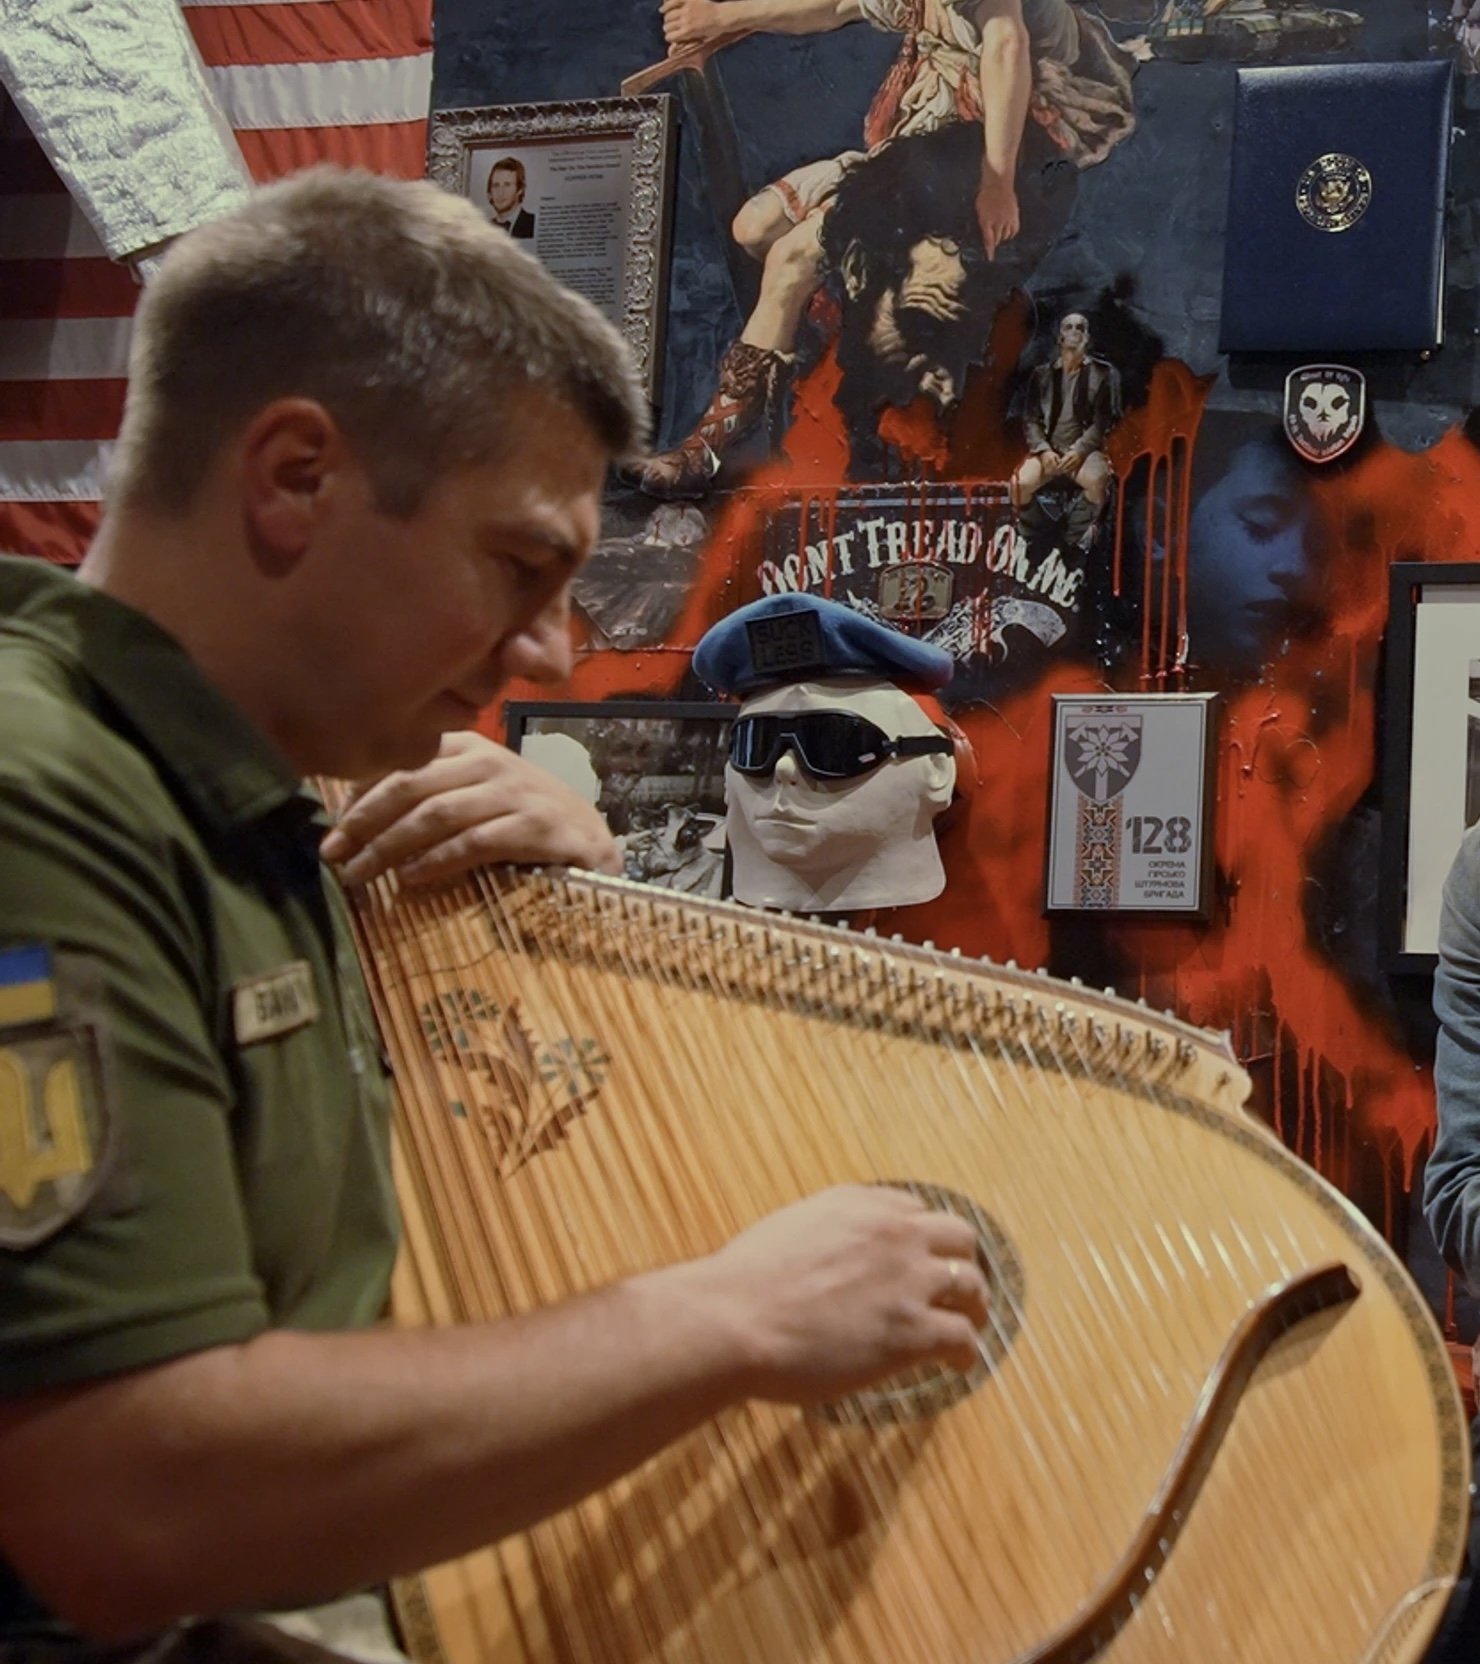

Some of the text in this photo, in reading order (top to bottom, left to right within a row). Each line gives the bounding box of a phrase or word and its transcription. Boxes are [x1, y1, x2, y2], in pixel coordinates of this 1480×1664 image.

[857, 517, 983, 569] TREAD
[986, 524, 1030, 583] ON
[1126, 815, 1192, 854] 128
